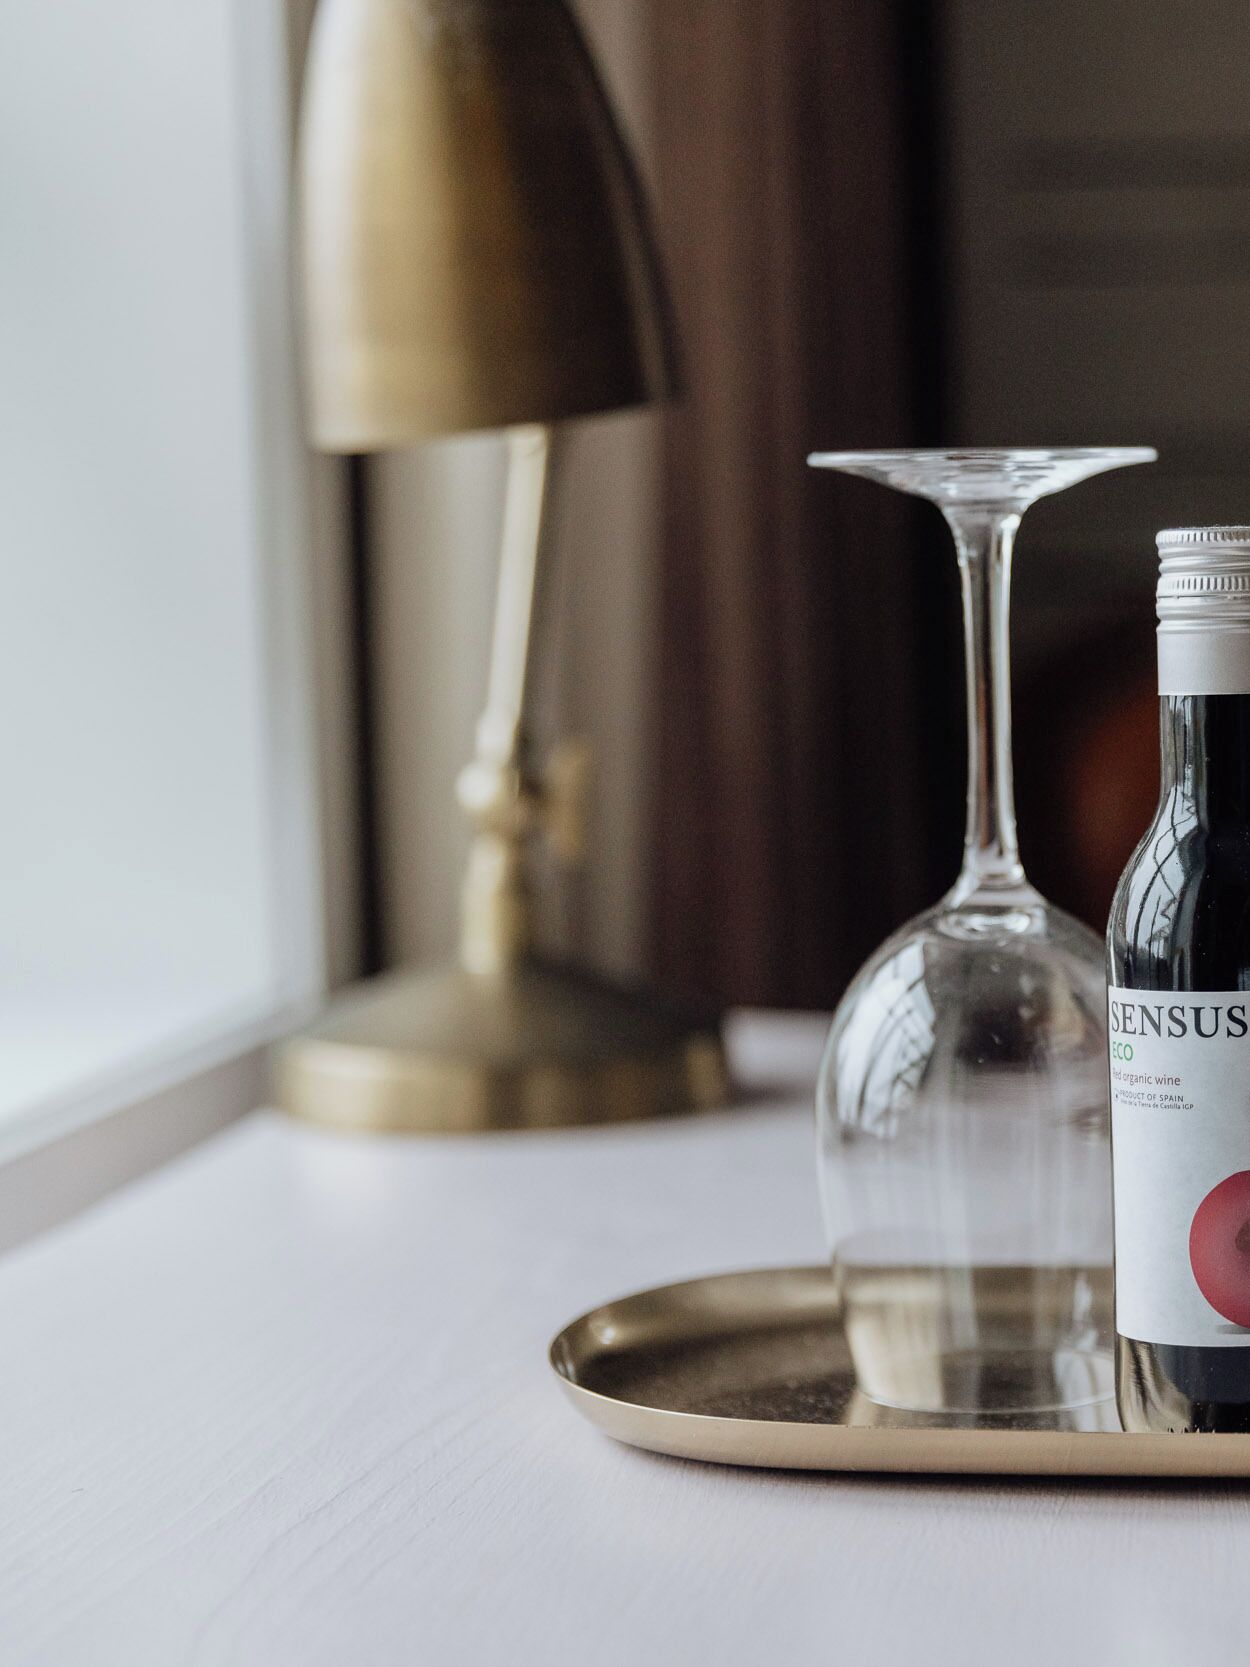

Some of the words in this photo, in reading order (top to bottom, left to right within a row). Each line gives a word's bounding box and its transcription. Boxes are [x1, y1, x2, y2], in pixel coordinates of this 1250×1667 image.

[1111, 1001, 1248, 1038] SENSUS
[1112, 1041, 1134, 1061] ECO
[1122, 1073, 1153, 1086] organic
[1155, 1074, 1181, 1086] wine
[1119, 1089, 1145, 1101] PRODUCT
[1147, 1093, 1157, 1101] OF
[1159, 1094, 1184, 1102] SPAIN
